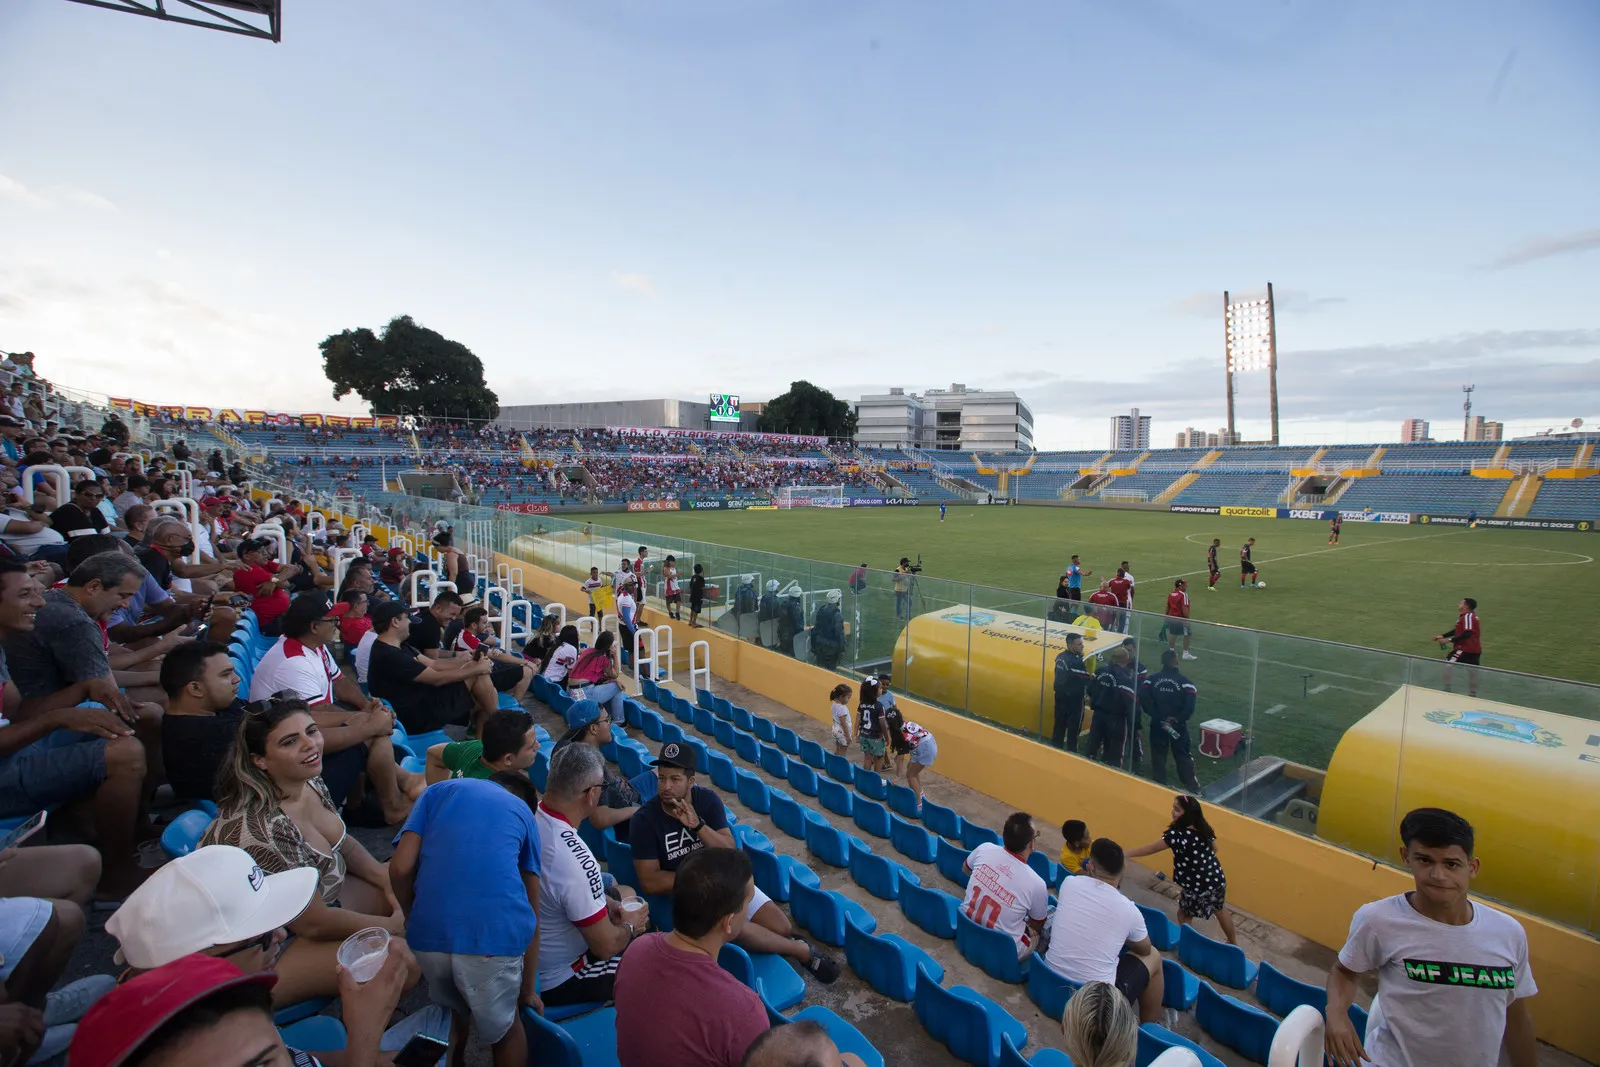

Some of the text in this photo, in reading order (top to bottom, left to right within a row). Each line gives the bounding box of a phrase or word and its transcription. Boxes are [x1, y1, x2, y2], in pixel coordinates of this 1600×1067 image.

[630, 502, 644, 510] GOL
[665, 501, 679, 509] GOL
[1225, 507, 1271, 516] quartzolit
[1288, 510, 1324, 520] 1XBET
[981, 628, 1023, 642] Esporte
[863, 709, 872, 730] 9
[665, 827, 700, 853] EA
[667, 846, 690, 861] EMPORIO
[980, 865, 999, 881] GRUPO
[966, 885, 1002, 929] 10
[1405, 961, 1516, 987] MF JEANS
